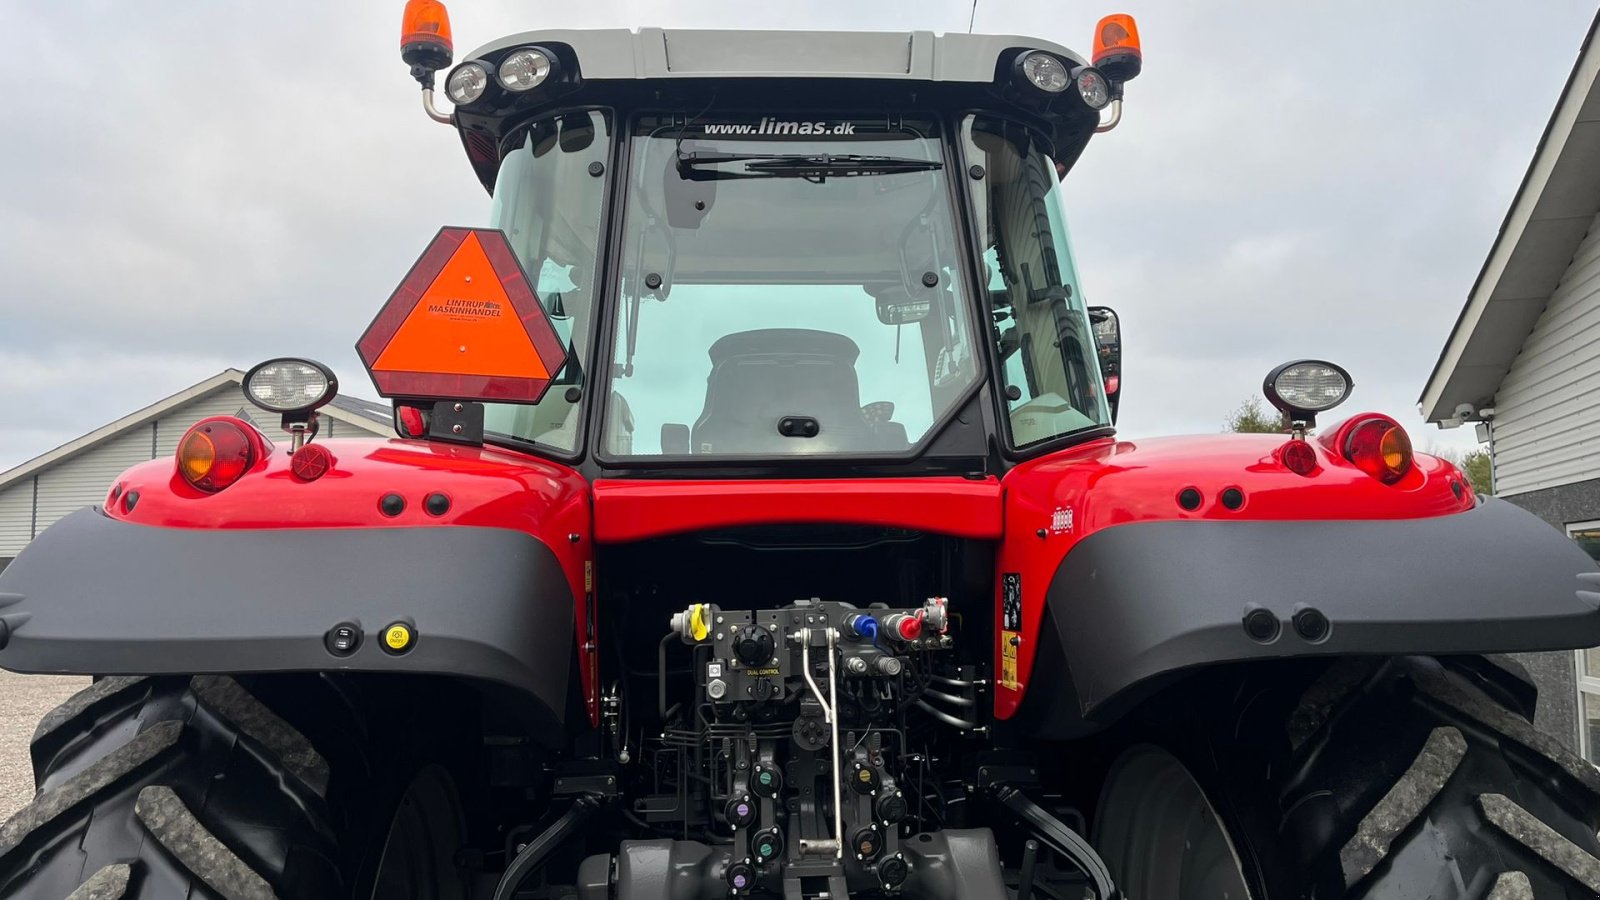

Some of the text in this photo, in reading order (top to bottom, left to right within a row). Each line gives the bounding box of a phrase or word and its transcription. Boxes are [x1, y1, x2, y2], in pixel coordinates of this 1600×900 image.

[704, 117, 856, 135] www.limas.dk
[428, 304, 502, 317] MASKINHANDEL
[446, 299, 485, 309] LINTRUP
